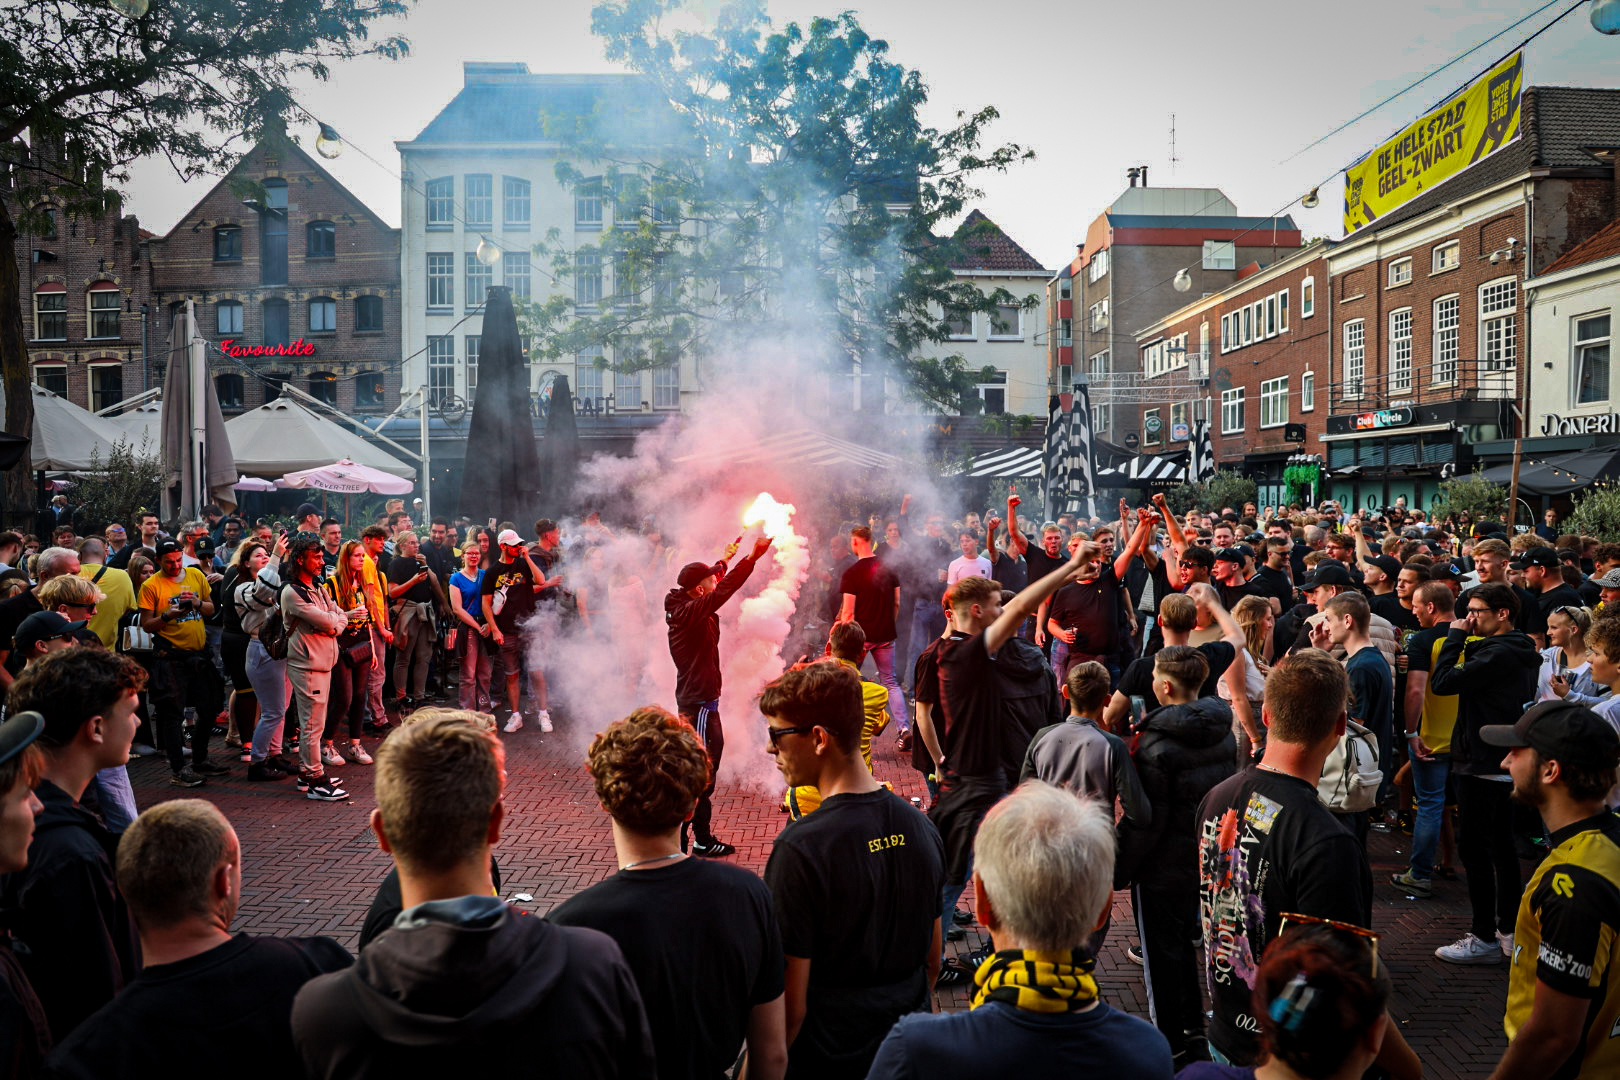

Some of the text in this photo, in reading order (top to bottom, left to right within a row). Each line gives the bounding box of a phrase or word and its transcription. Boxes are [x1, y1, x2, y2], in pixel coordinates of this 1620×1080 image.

[1378, 100, 1467, 175] DE HELE STAD
[1379, 123, 1465, 198] GEEL-ZWART
[220, 337, 316, 358] Favourite
[1357, 412, 1402, 425] Club Circle
[314, 479, 360, 491] FEVER-TREE
[1570, 960, 1592, 979] ZOO
